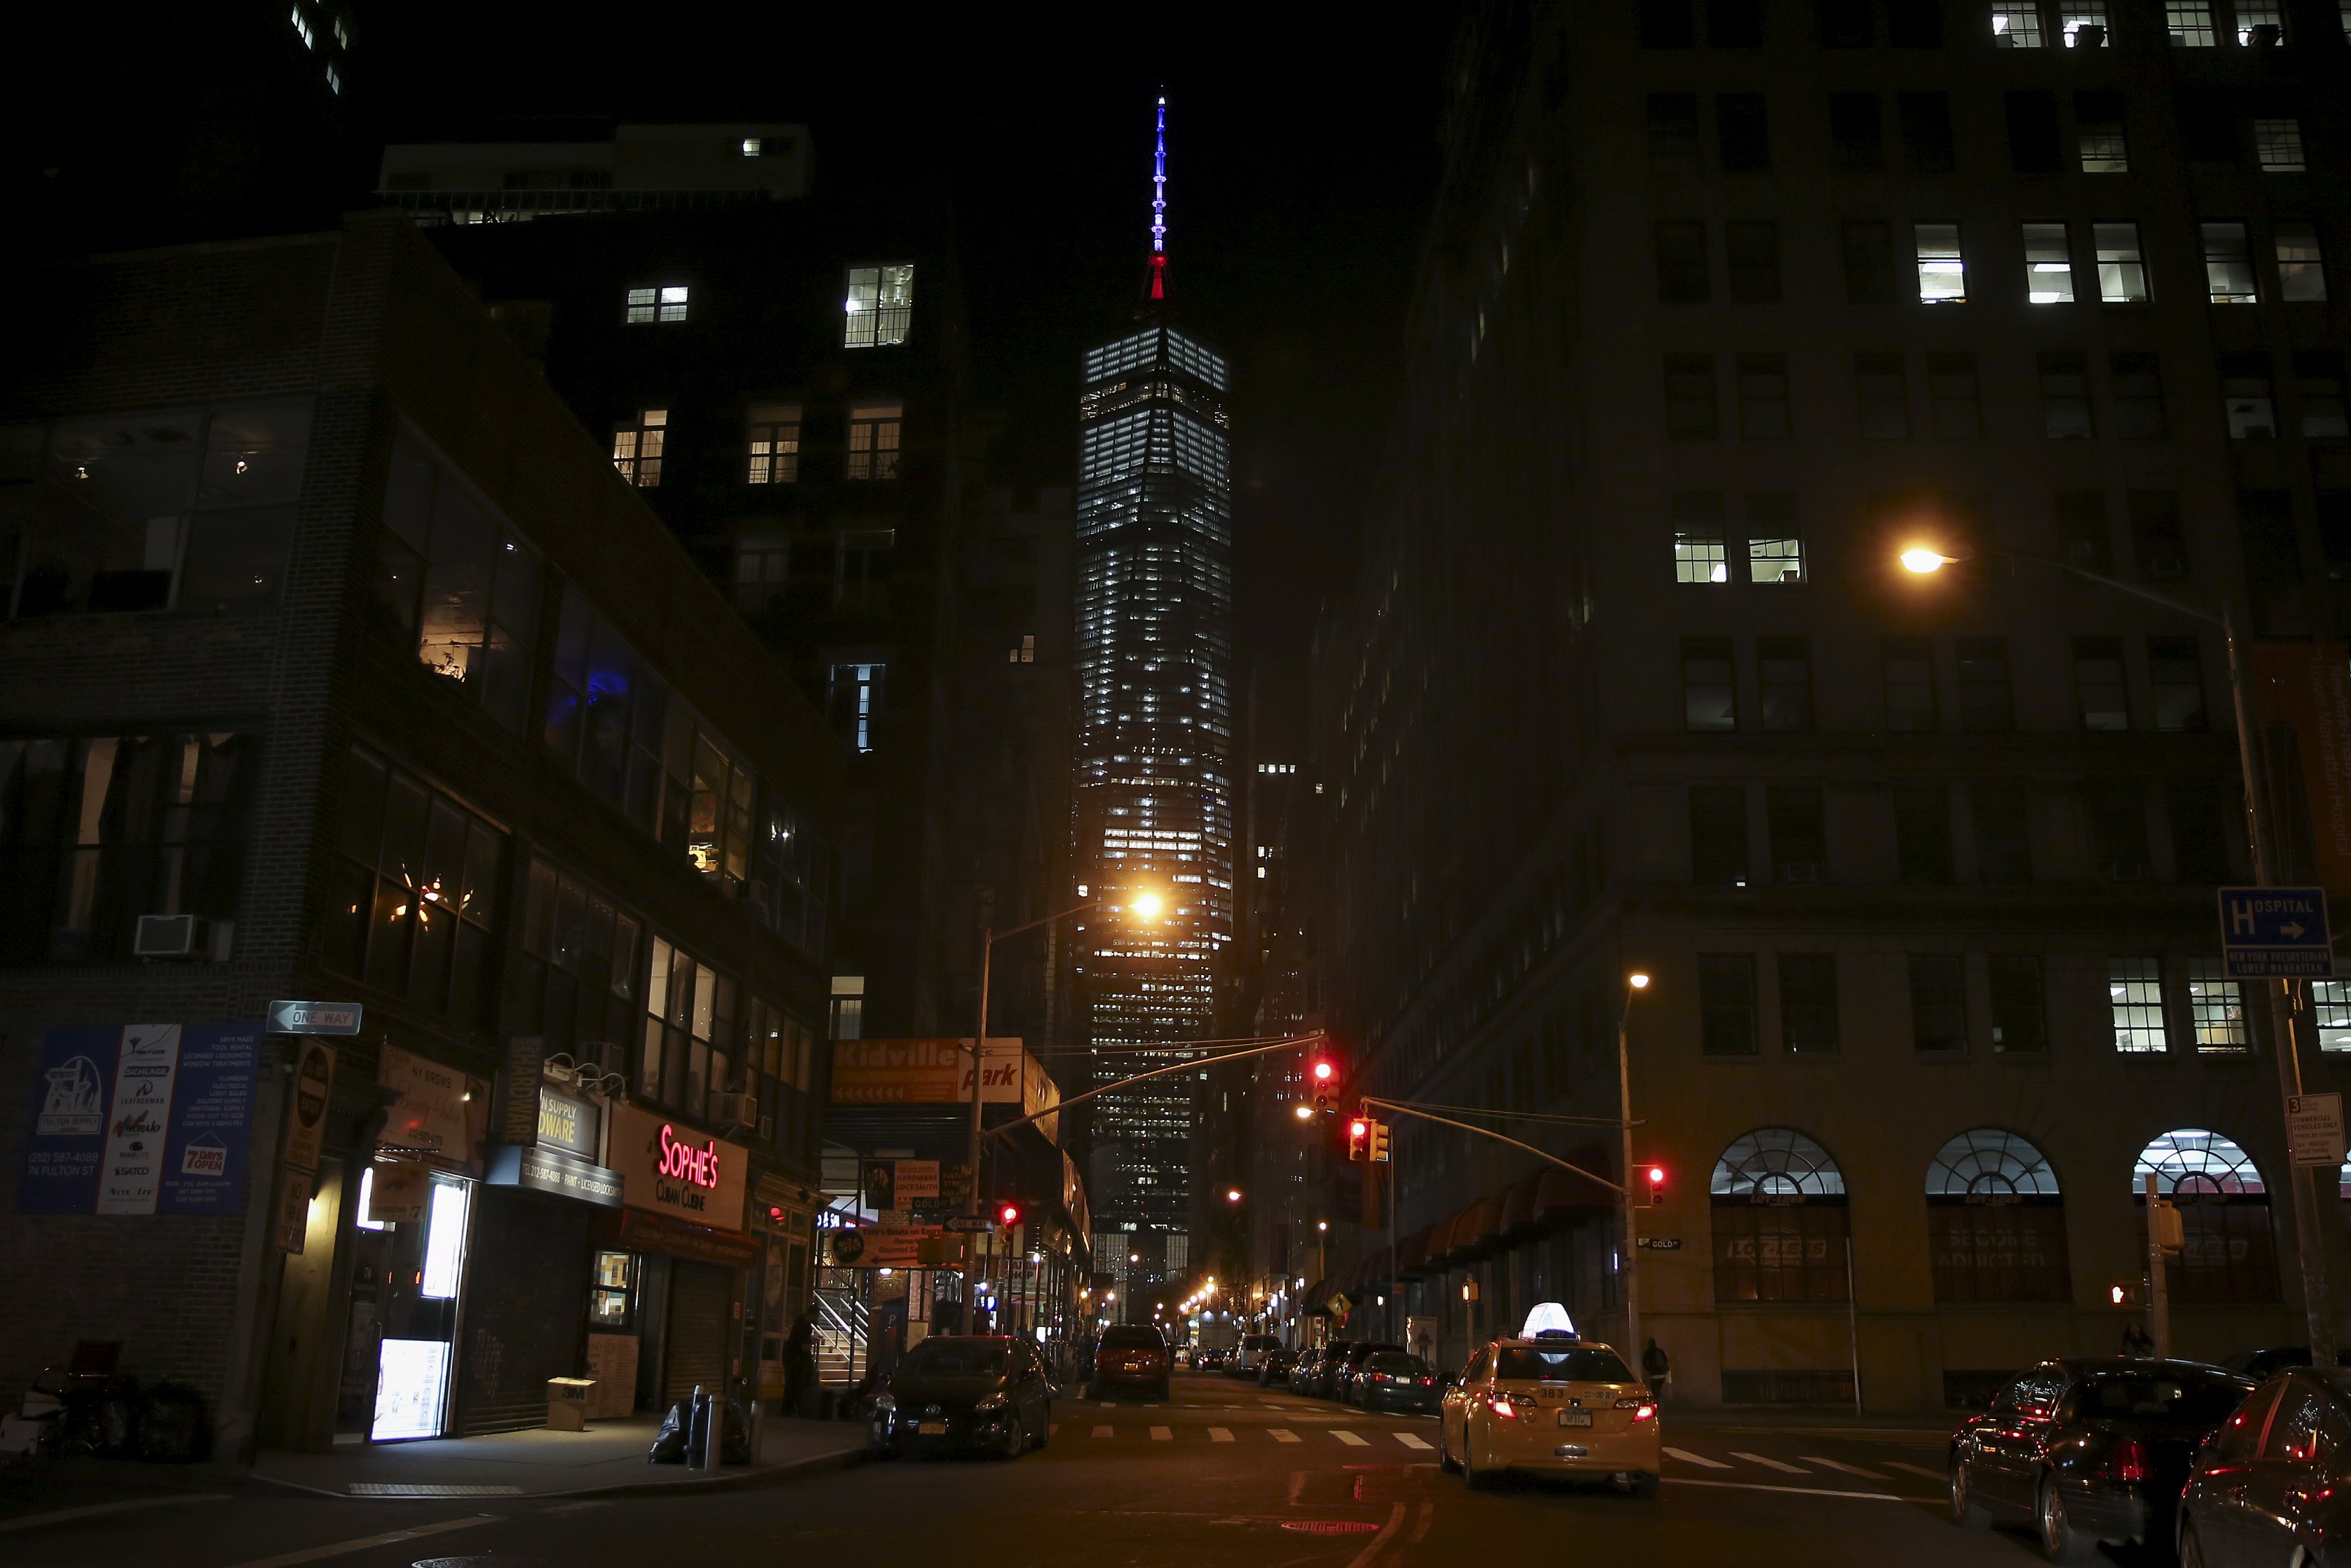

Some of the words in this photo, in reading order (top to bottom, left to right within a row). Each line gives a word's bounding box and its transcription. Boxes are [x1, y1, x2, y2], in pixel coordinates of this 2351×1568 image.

[2310, 665, 2327, 708] Lower
[2317, 711, 2340, 791] Manhattan
[2329, 795, 2351, 856] Hospital
[2231, 900, 2314, 935] HOSPITAL
[2229, 952, 2245, 961] NEW
[2247, 952, 2268, 961] YORK
[2271, 952, 2328, 961] PRESBYTERIAN
[2237, 964, 2266, 974] LOWER
[2270, 964, 2323, 974] MANHATTAN
[293, 1010, 317, 1024] ONE
[324, 1012, 349, 1025] WAY
[837, 1042, 956, 1066] Kidville
[412, 1066, 423, 1078] NY
[425, 1069, 451, 1089] BROWS
[962, 1063, 1017, 1091] park
[505, 1054, 538, 1144] HARDWARE
[2291, 1099, 2299, 1111] 3
[549, 1099, 577, 1119] SUPPLY
[43, 1117, 70, 1125] FULTON
[2292, 1115, 2331, 1123] COMMERCIAL
[2293, 1123, 2321, 1131] VEHICLES
[28, 1152, 51, 1164] (212)
[53, 1152, 99, 1162] 587-4088
[187, 1150, 198, 1168] 7
[199, 1150, 223, 1161] DAYS
[659, 1123, 719, 1189] SOPHIE'S
[28, 1165, 40, 1176] 74
[42, 1165, 79, 1176] FULTON
[82, 1165, 95, 1175] ST
[121, 1166, 149, 1175] SATCO
[194, 1159, 222, 1170] OPEN
[523, 1162, 531, 1176] TEL
[531, 1165, 562, 1183] 212-587-4088
[564, 1173, 578, 1187] PAINT
[581, 1179, 601, 1194] LICENSED
[656, 1179, 680, 1205] CUBAN
[682, 1185, 705, 1211] CUISINE
[1750, 1195, 1807, 1204] LOT-LESS
[914, 1199, 941, 1208] GOLD
[972, 1219, 987, 1227] WAY
[863, 1229, 885, 1237] Toby's
[1949, 1230, 2038, 1246] BECOME
[562, 1385, 585, 1399] 3M
[1541, 1389, 1564, 1398] 383
